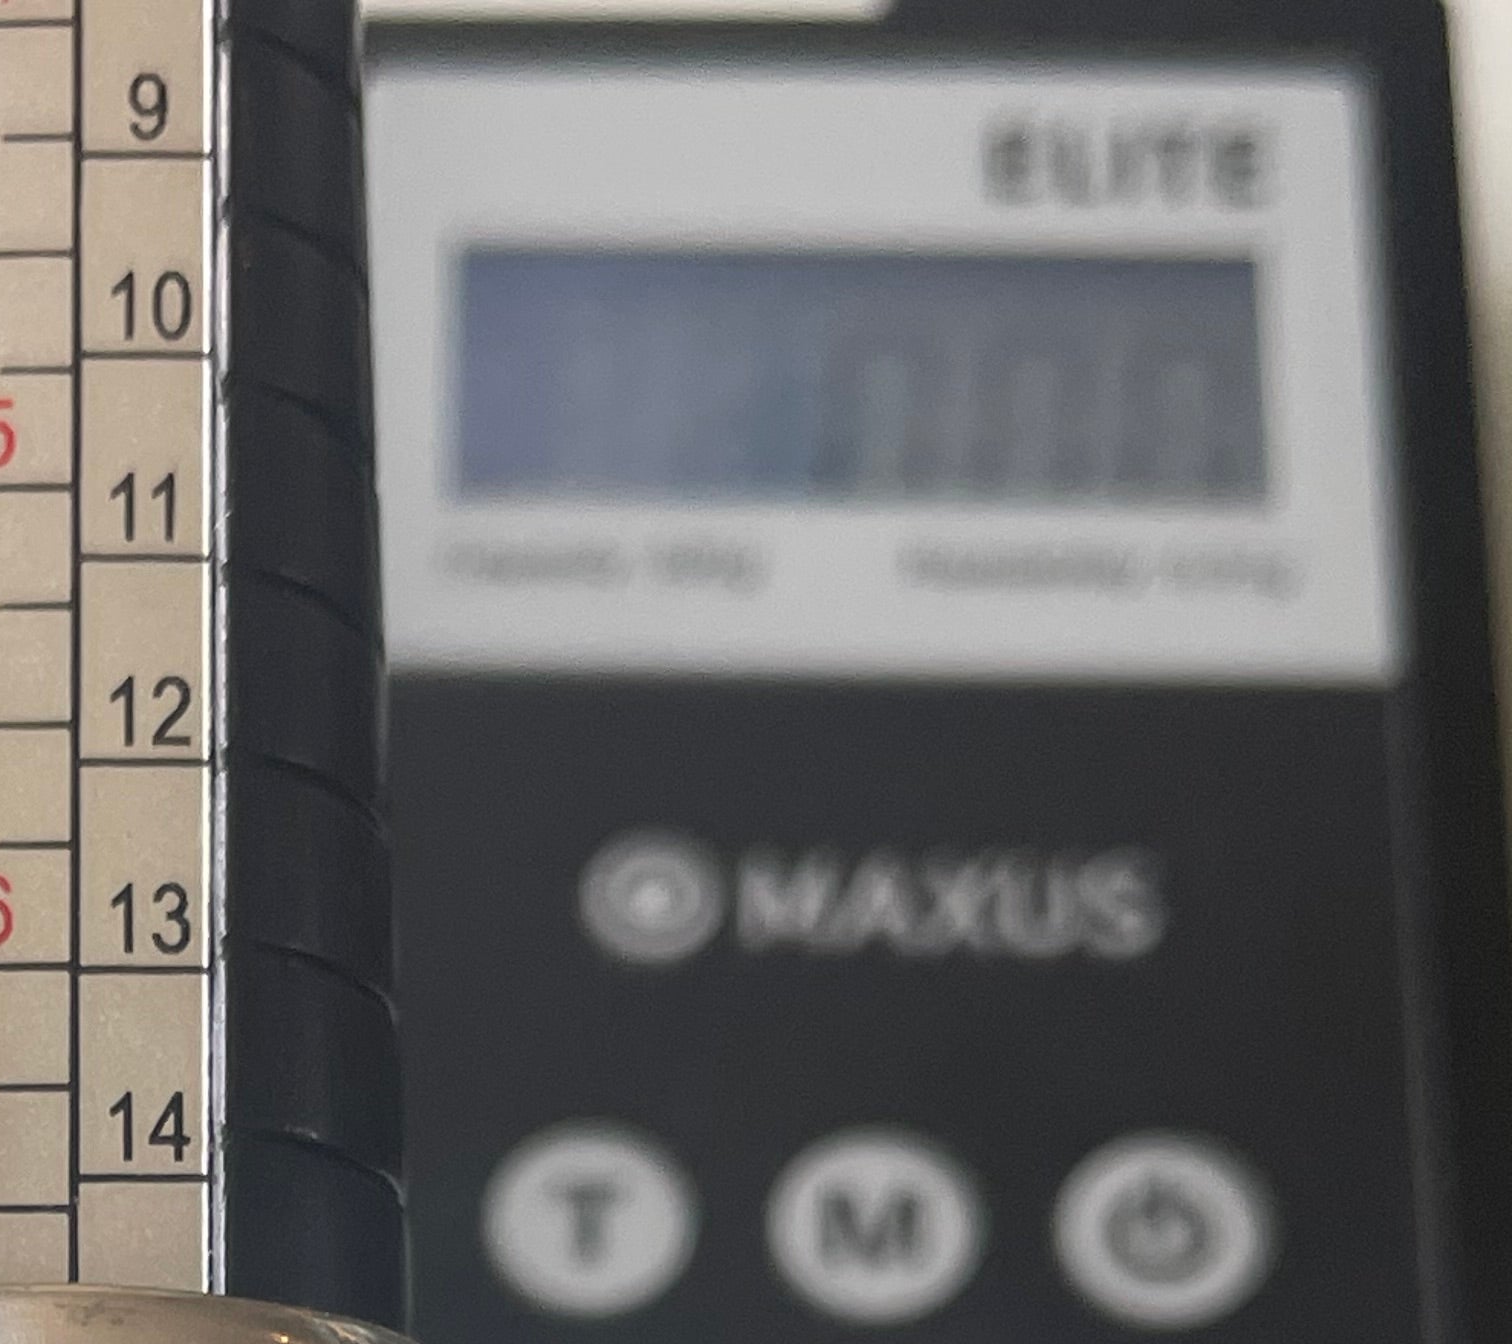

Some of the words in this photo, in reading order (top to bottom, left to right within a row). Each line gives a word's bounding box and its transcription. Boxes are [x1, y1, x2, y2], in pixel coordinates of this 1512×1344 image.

[128, 72, 169, 142] 9
[110, 269, 193, 343] 10
[109, 470, 177, 544] 11
[108, 674, 193, 749] 12
[108, 880, 193, 956] 13
[736, 848, 1164, 958] MAXUS
[108, 1089, 193, 1163] 14
[546, 1178, 624, 1272] T
[814, 1190, 928, 1270] M
